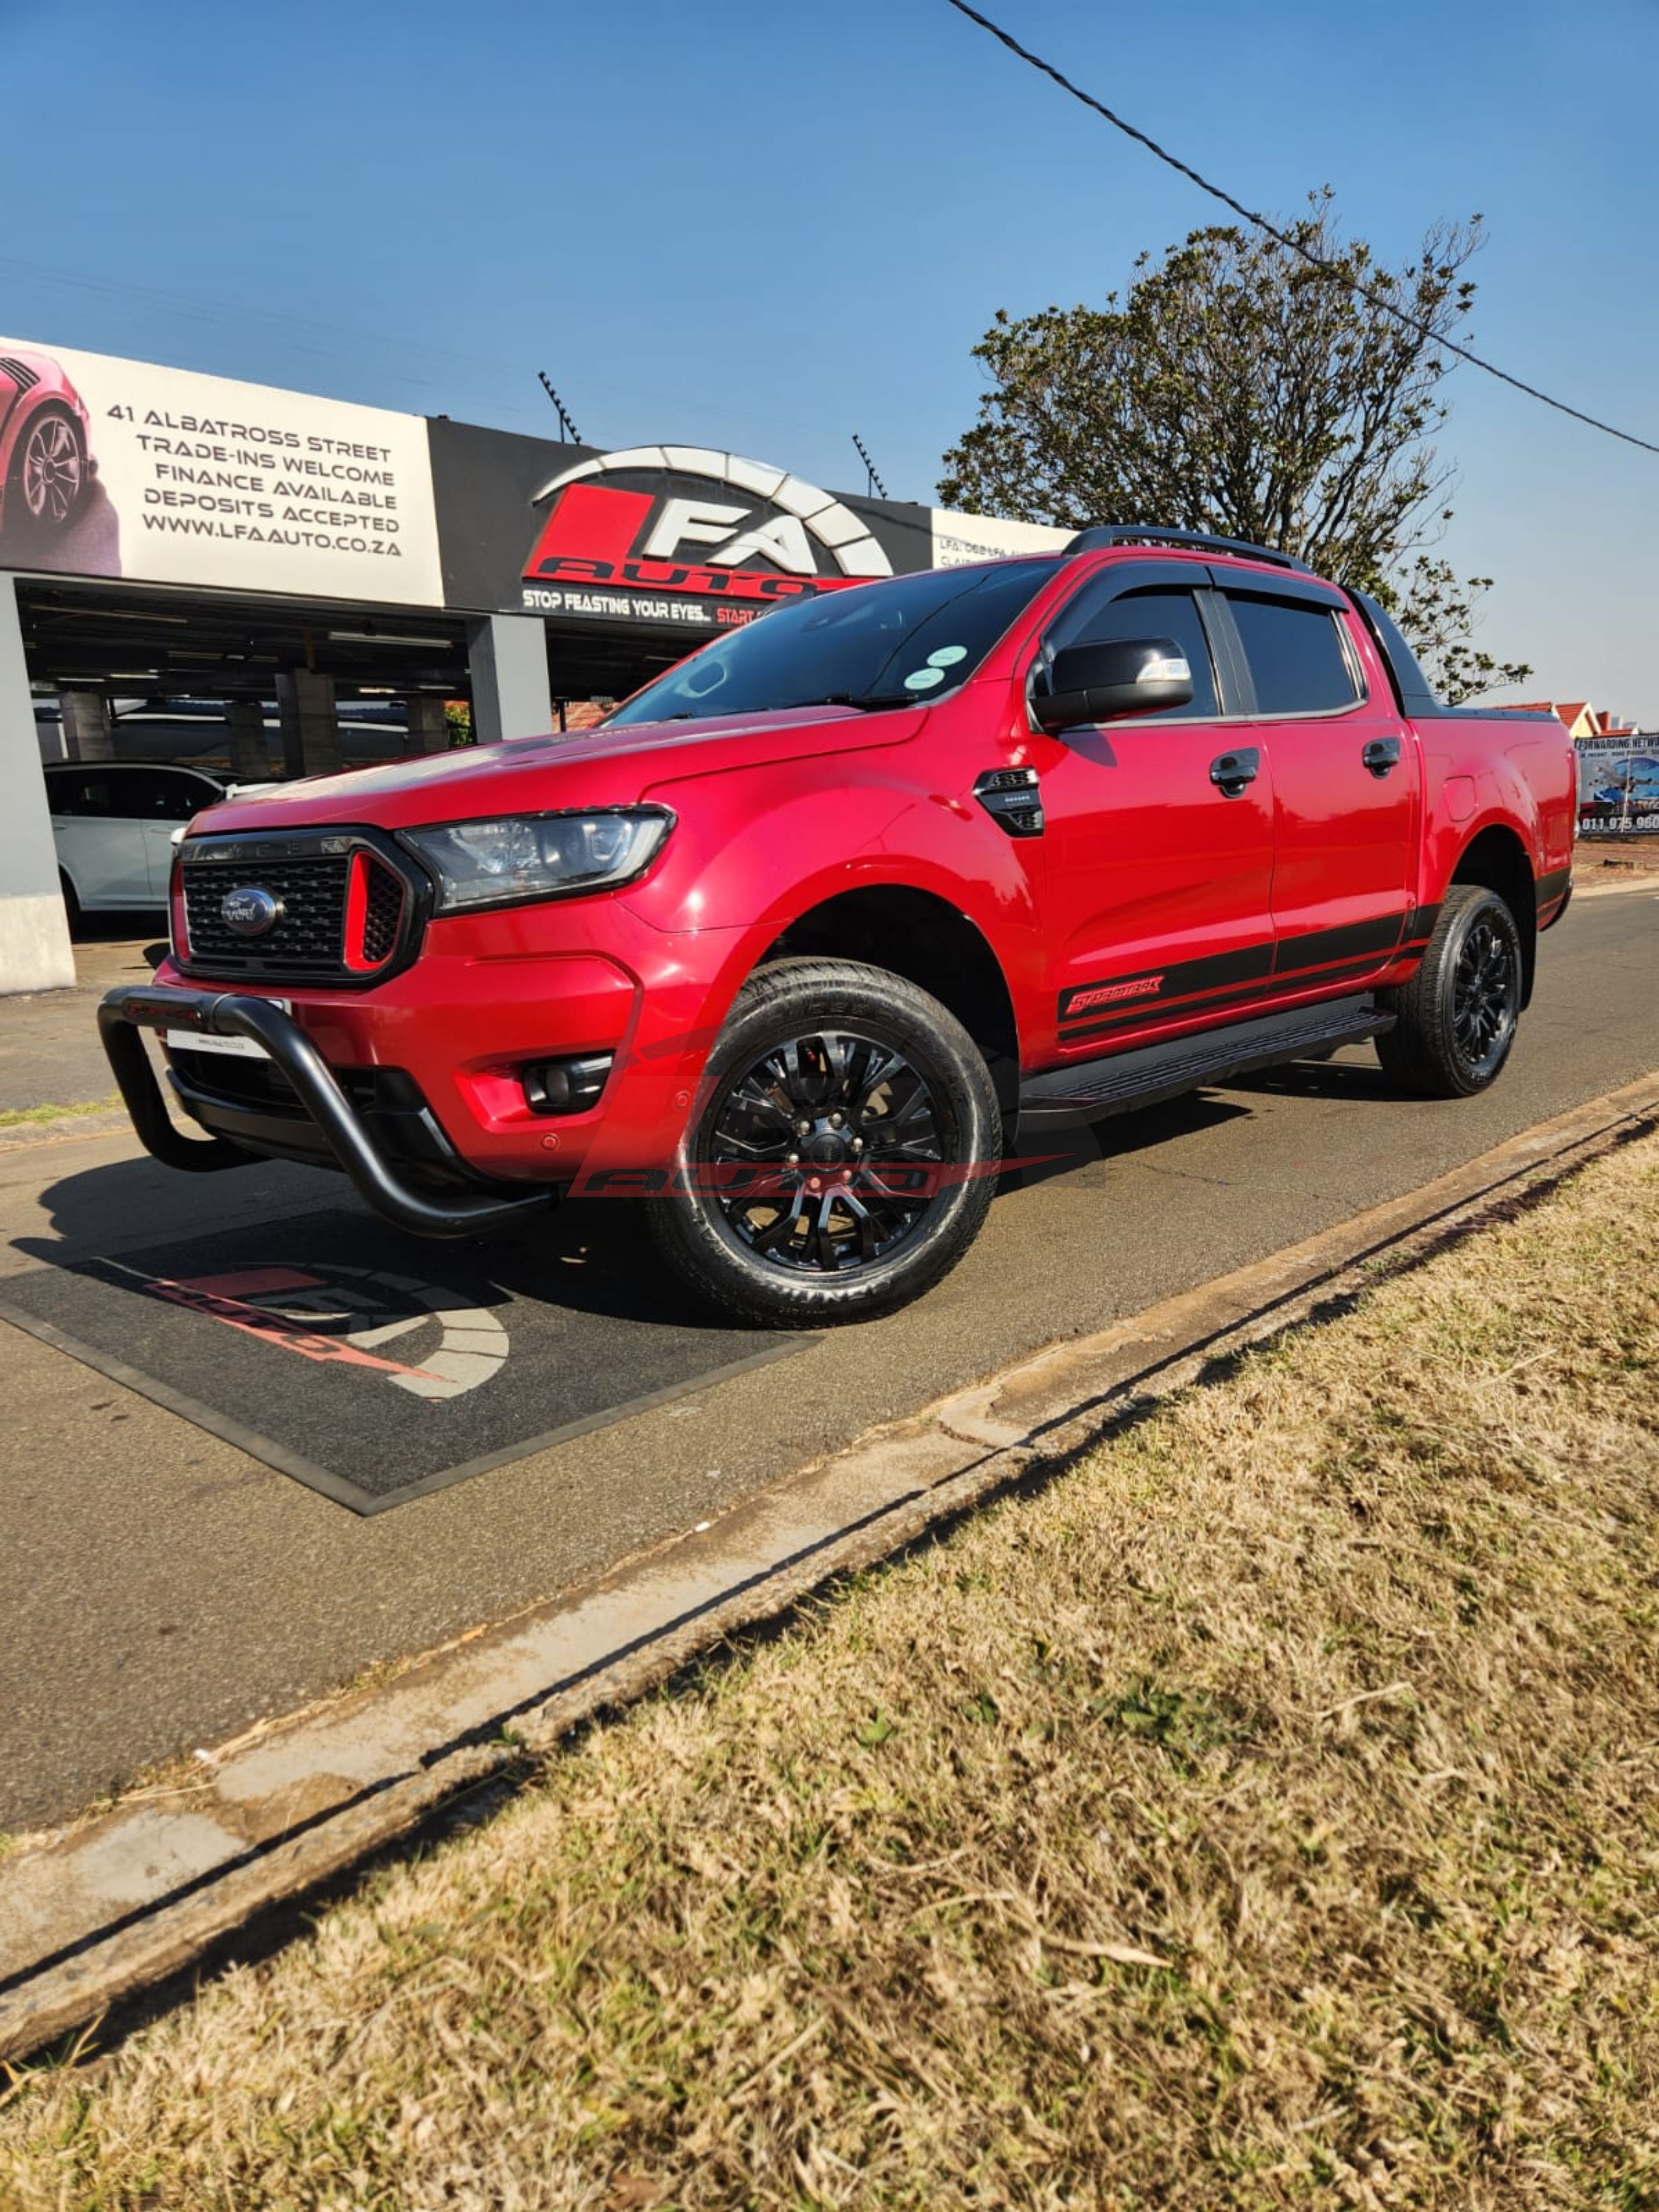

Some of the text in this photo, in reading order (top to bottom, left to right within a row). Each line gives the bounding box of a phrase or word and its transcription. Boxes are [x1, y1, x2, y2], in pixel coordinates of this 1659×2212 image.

[107, 404, 391, 462] 41 ALBATROSS STREET
[135, 434, 394, 486] TRADE-INS WELCOME
[155, 463, 397, 509] FINANCE AVAILABLE
[144, 488, 399, 532] DEPOSITS ACCEPTED
[142, 513, 402, 556] WWW.LFAAUTO.CO.ZA
[537, 556, 820, 596] AUTO
[522, 590, 562, 609] STOP
[564, 593, 630, 615] FEASTING
[631, 599, 669, 618] YOUR
[716, 607, 754, 624] START
[1582, 818, 1605, 831] 011
[1609, 817, 1632, 830] 975
